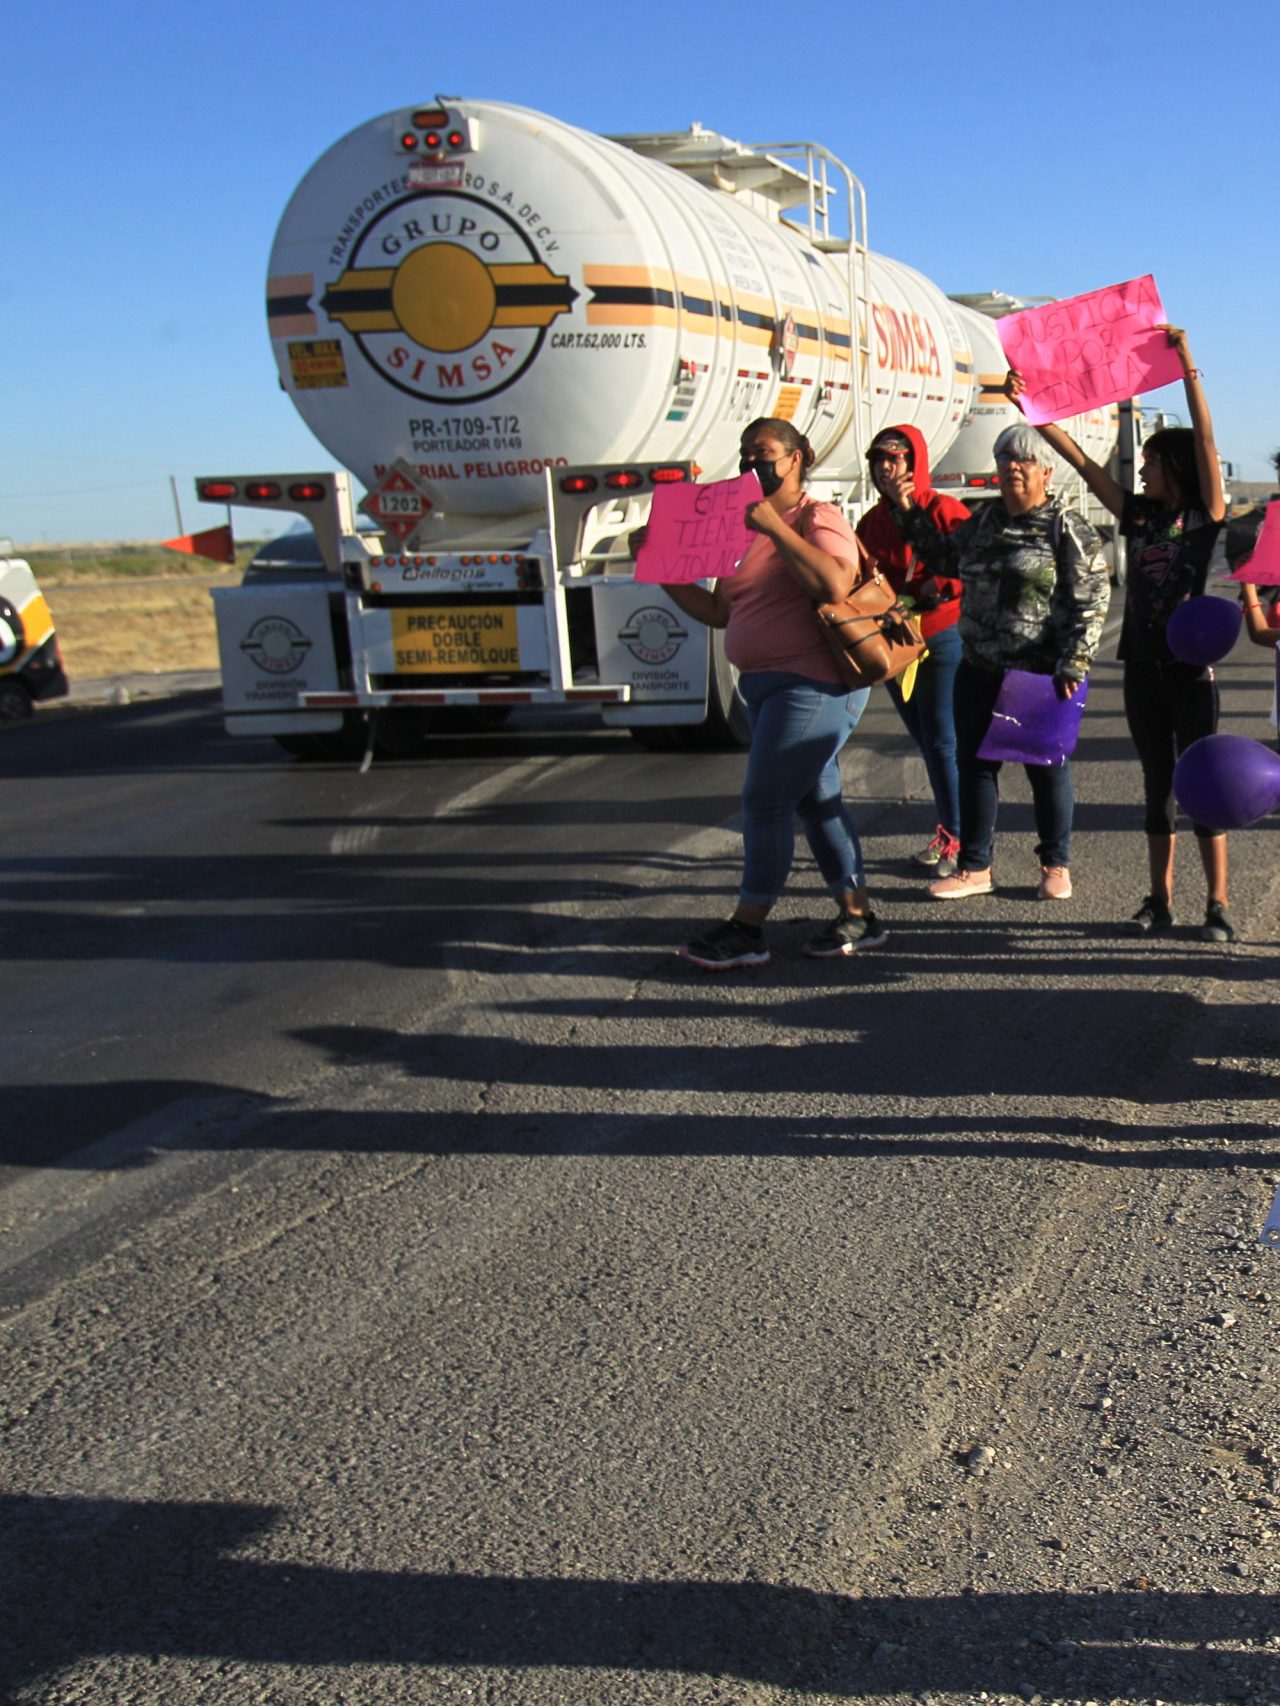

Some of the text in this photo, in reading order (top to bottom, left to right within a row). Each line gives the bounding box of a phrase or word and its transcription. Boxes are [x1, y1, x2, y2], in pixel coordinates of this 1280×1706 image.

[518, 203, 541, 227] DE
[382, 214, 499, 255] GRUPO
[1008, 281, 1161, 348] JUSTICIA
[872, 303, 941, 377] SIMSA
[1059, 328, 1120, 372] POR
[387, 341, 516, 388] SIMSA
[1031, 354, 1149, 414] CINTIA
[409, 415, 521, 437] PR-1709-T/2
[413, 437, 522, 453] PORTEADOR 0149
[381, 497, 421, 512] 1202
[407, 611, 503, 631] PRECAUCIÓN
[432, 632, 481, 648] DOBLE
[396, 647, 519, 666] SEMI-REMOLQUE
[632, 669, 679, 680] DIVISIÓN
